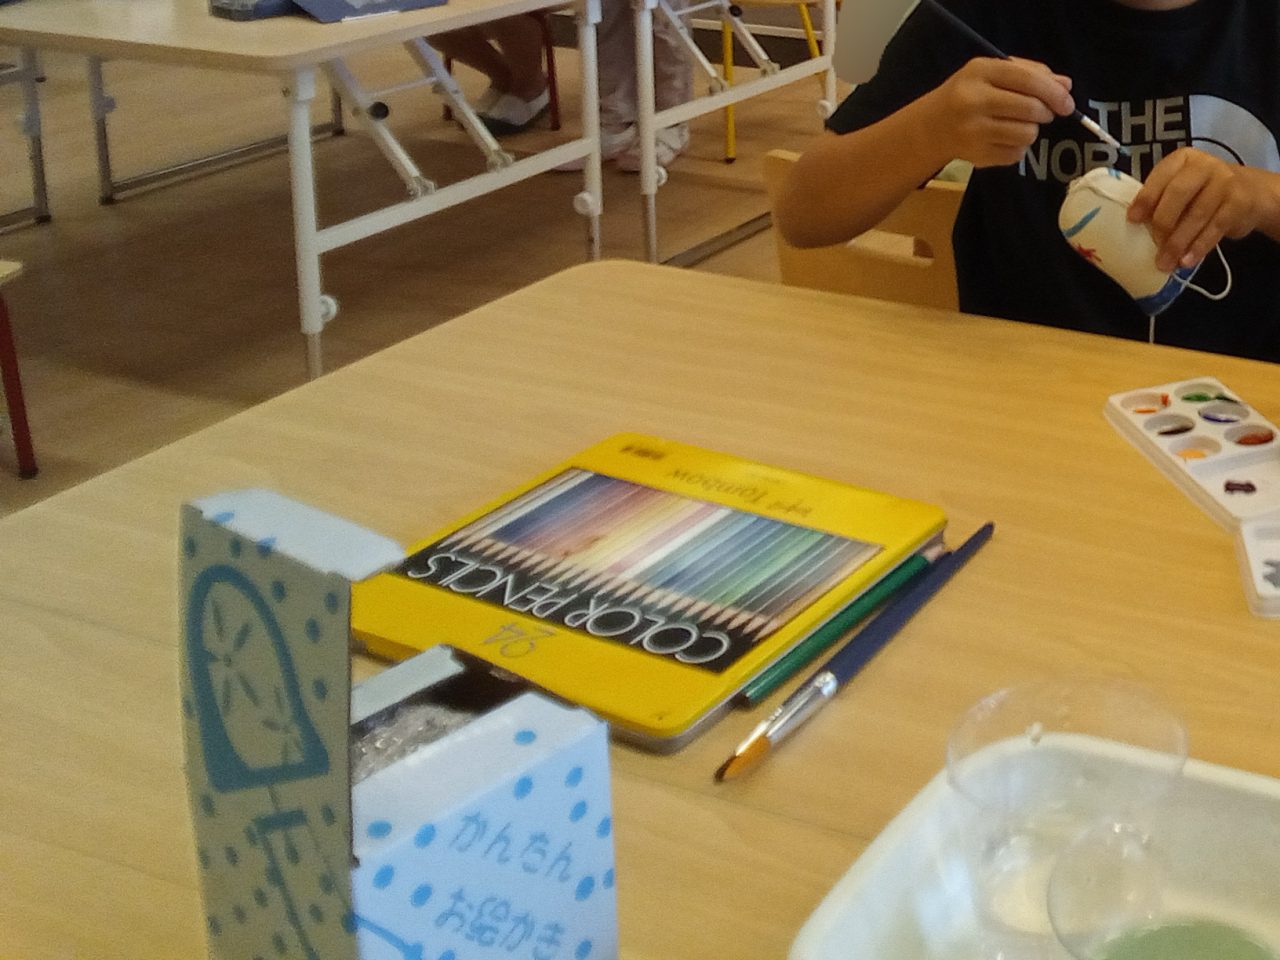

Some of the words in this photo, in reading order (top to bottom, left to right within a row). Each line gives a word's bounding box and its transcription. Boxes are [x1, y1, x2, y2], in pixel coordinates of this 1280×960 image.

[1088, 96, 1187, 143] THE
[407, 553, 578, 619] PENCILS
[564, 590, 730, 664] COLOR
